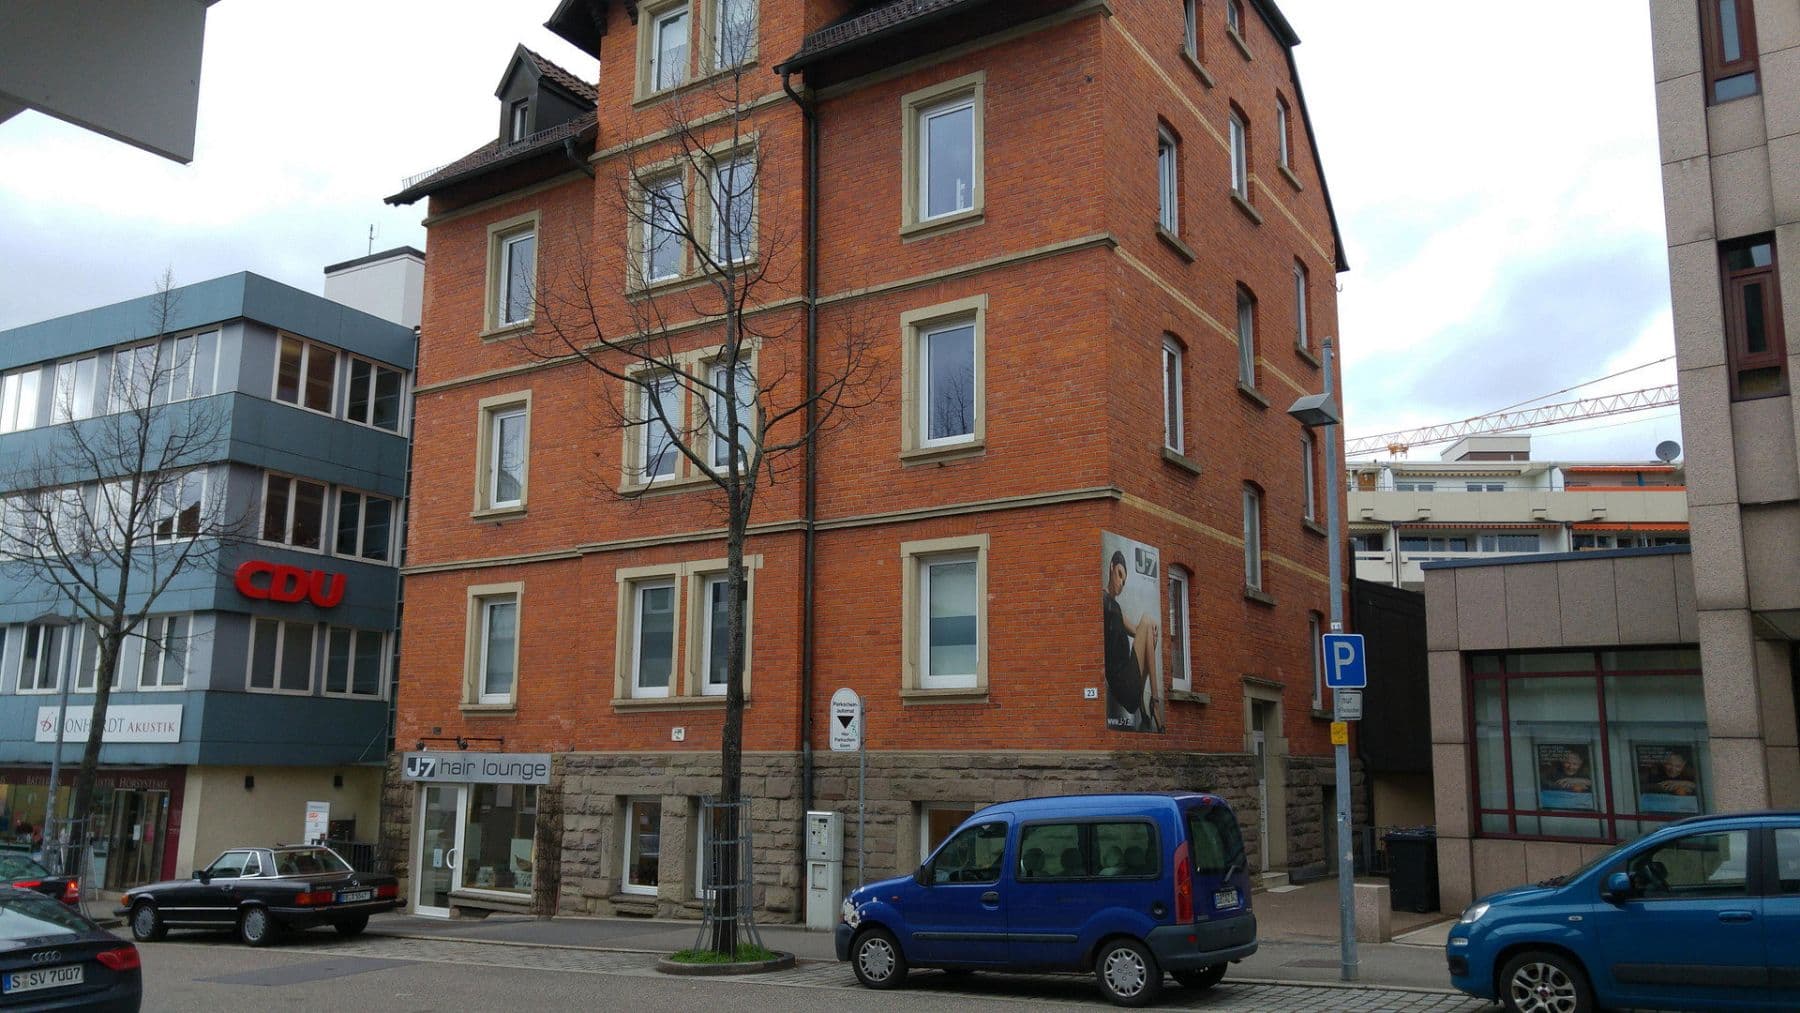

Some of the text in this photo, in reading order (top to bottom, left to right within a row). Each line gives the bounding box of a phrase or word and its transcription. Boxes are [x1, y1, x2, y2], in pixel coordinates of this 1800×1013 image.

[234, 560, 349, 608] CDU
[1333, 641, 1355, 680] P
[1087, 689, 1096, 697] 23
[127, 721, 176, 733] AKUSTIK
[440, 758, 476, 776] hair
[482, 758, 547, 780] lounge
[12, 967, 80, 988] S SV 7007
